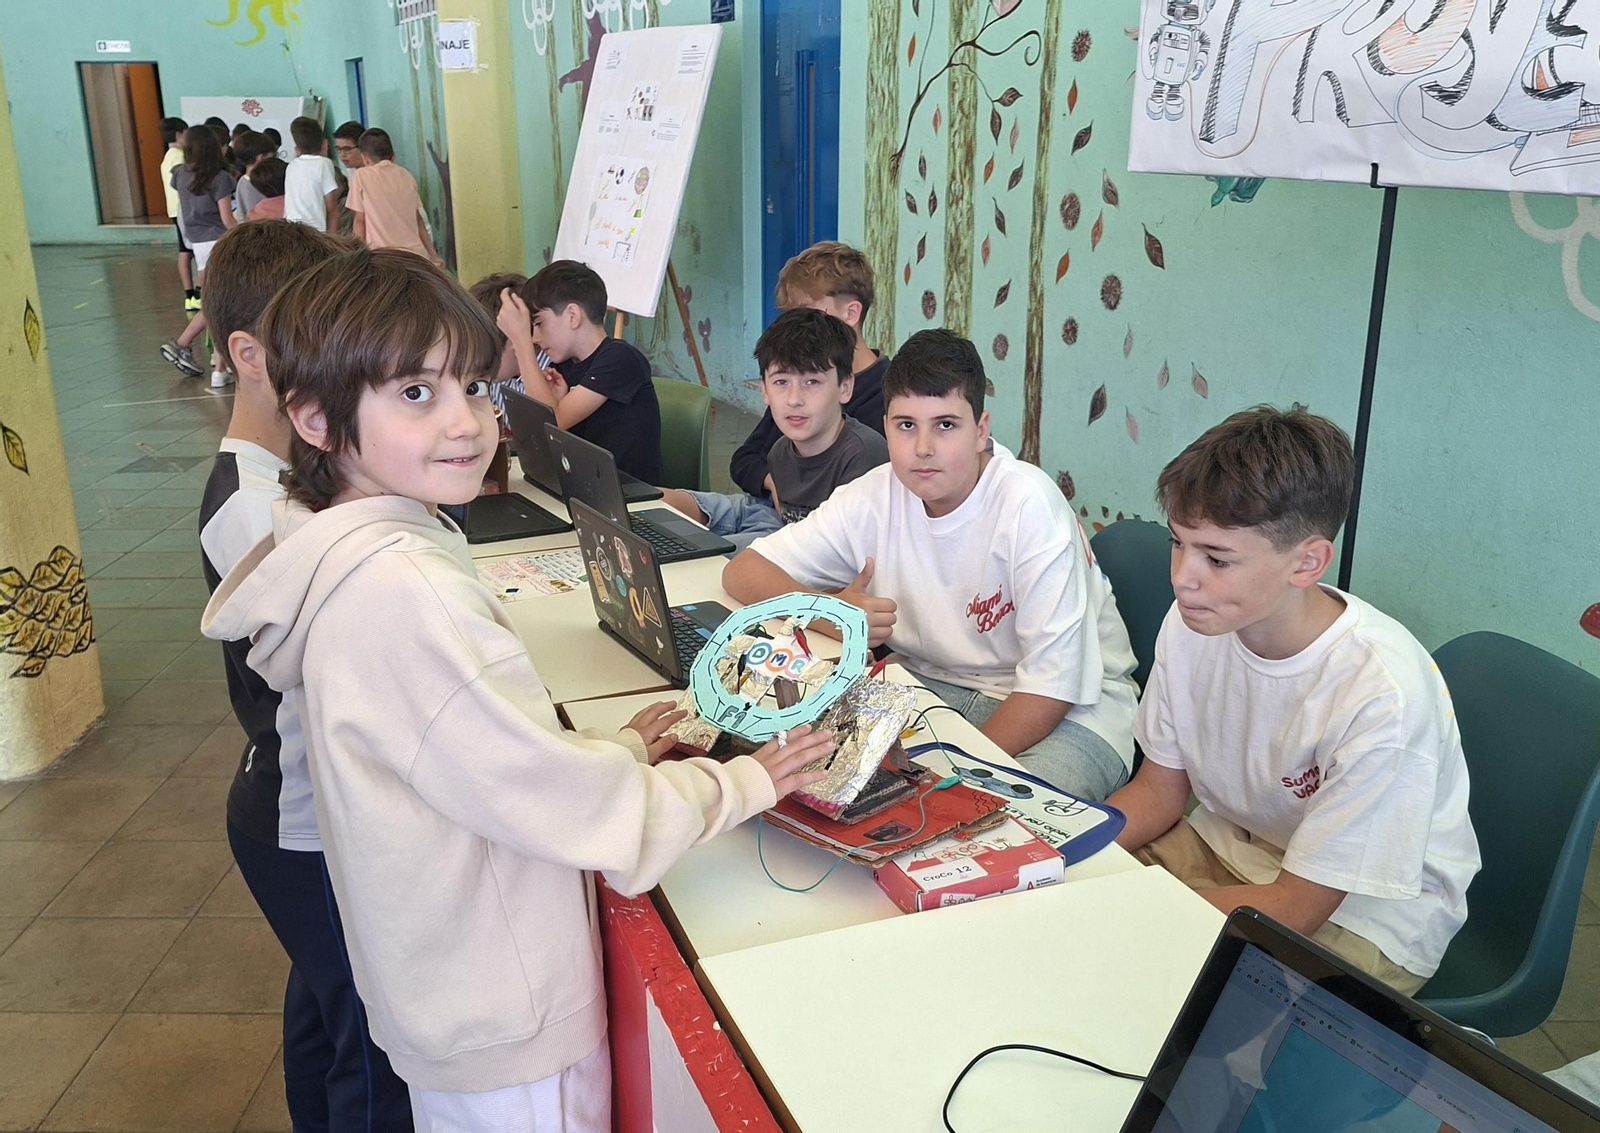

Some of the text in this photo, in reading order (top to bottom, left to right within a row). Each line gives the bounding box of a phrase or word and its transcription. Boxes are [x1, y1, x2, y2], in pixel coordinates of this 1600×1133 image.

[1199, 0, 1600, 144] PROJE
[717, 705, 747, 729] F1
[922, 871, 953, 882] CroCo
[955, 865, 972, 874] 12
